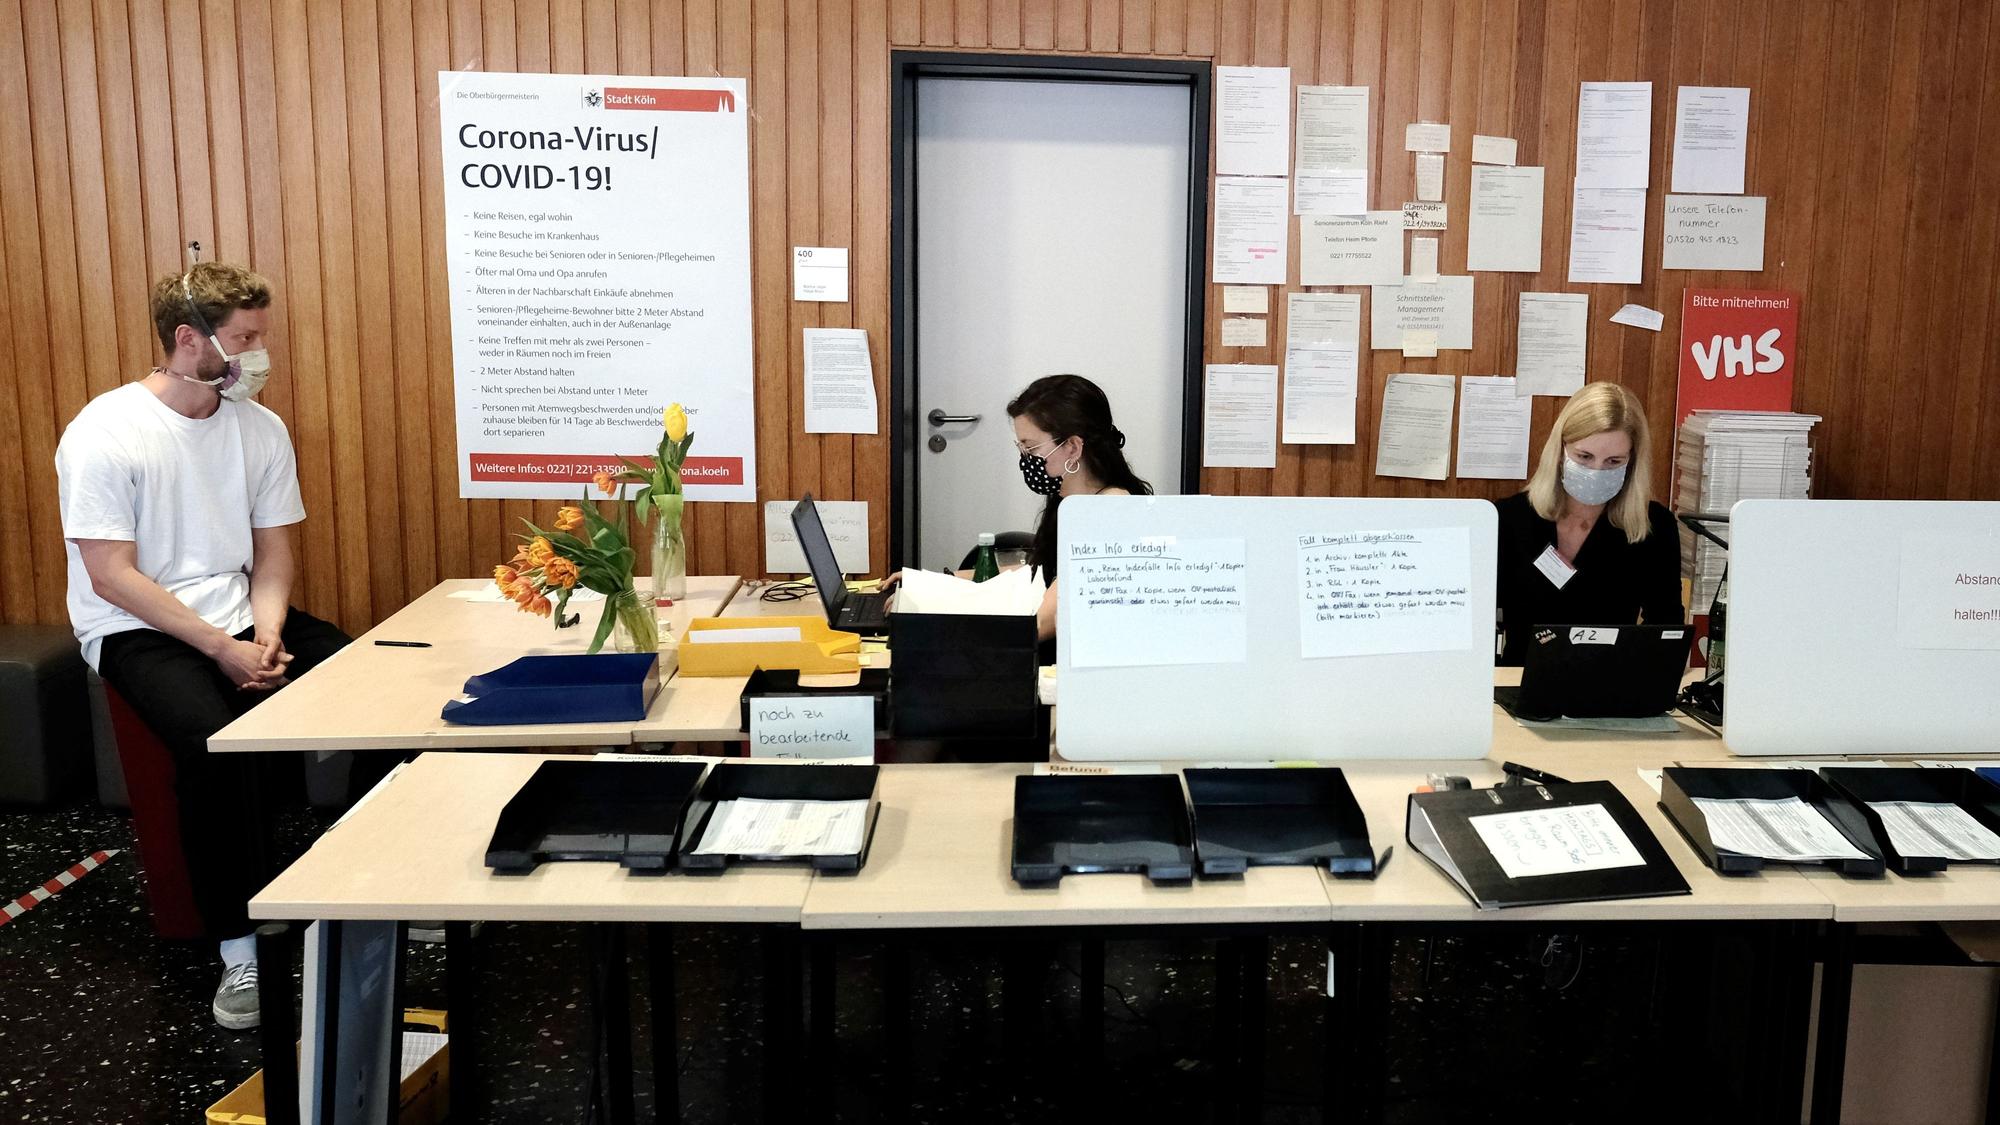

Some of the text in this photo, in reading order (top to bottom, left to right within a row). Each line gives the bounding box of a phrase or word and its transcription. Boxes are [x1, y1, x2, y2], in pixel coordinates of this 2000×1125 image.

[469, 91, 539, 101] Oberbürgermeisterin
[606, 93, 656, 104] Stadt Köln
[459, 122, 658, 159] Corona-Virus/
[461, 163, 611, 191] COVID-19!
[473, 211, 572, 222] Keine Reisen, egal wohin
[1679, 220, 1721, 228] nummer
[474, 230, 599, 240] Keine Besuche im Krankenhaus
[474, 248, 715, 263] Keine Besuche bei Senioren oder in Senioren-/Pflegeheimen
[475, 267, 607, 279] Öfter mal Oma und Opa anrufen
[476, 284, 505, 294] Älteren
[517, 287, 530, 295] der
[532, 287, 591, 296] Nachbarschaft
[593, 288, 627, 297] Einkäufe
[629, 288, 673, 298] abnehmen
[1693, 295, 1790, 310] Bitte mitnehmen!
[476, 304, 704, 317] Senioren-/Pflegeheime-Bewohner bitte 2 Meter Abstand
[477, 317, 671, 330] voneinander einhalten, auch in der Außenanlage
[478, 336, 501, 344] Keine
[503, 336, 531, 344] Treffen
[533, 337, 547, 345] mit
[549, 336, 571, 345] mehr
[573, 337, 584, 345] als
[606, 338, 643, 346] Personen
[479, 348, 504, 357] weder
[515, 348, 550, 357] Räumen
[551, 349, 572, 358] noch
[573, 350, 584, 358] im
[586, 349, 611, 358] Freien
[1691, 328, 1785, 381] VHS
[480, 366, 574, 376] 2 Meter Abstand halten
[480, 385, 503, 393] Nicht
[504, 385, 541, 395] sprechen
[543, 385, 556, 394] bei
[557, 386, 591, 394] Abstand
[617, 387, 622, 396] 1
[623, 387, 647, 395] Meter
[482, 404, 665, 416] Personen mit Atemwegsbeschwerden und/od
[483, 416, 515, 425] zuhause
[517, 415, 547, 424] bleiben
[548, 416, 560, 424] für
[574, 417, 593, 427] Tage
[595, 417, 605, 425] ab
[483, 427, 544, 438] dort separieren
[475, 463, 515, 473] Weitere
[517, 463, 544, 473] Infos:
[546, 463, 573, 476] 0221/
[1299, 536, 1315, 546] Fall
[1322, 534, 1357, 545] komplett
[1071, 541, 1168, 557] Index Info erledigt
[758, 706, 824, 722] noch zu
[759, 730, 851, 745] bearbeitende
